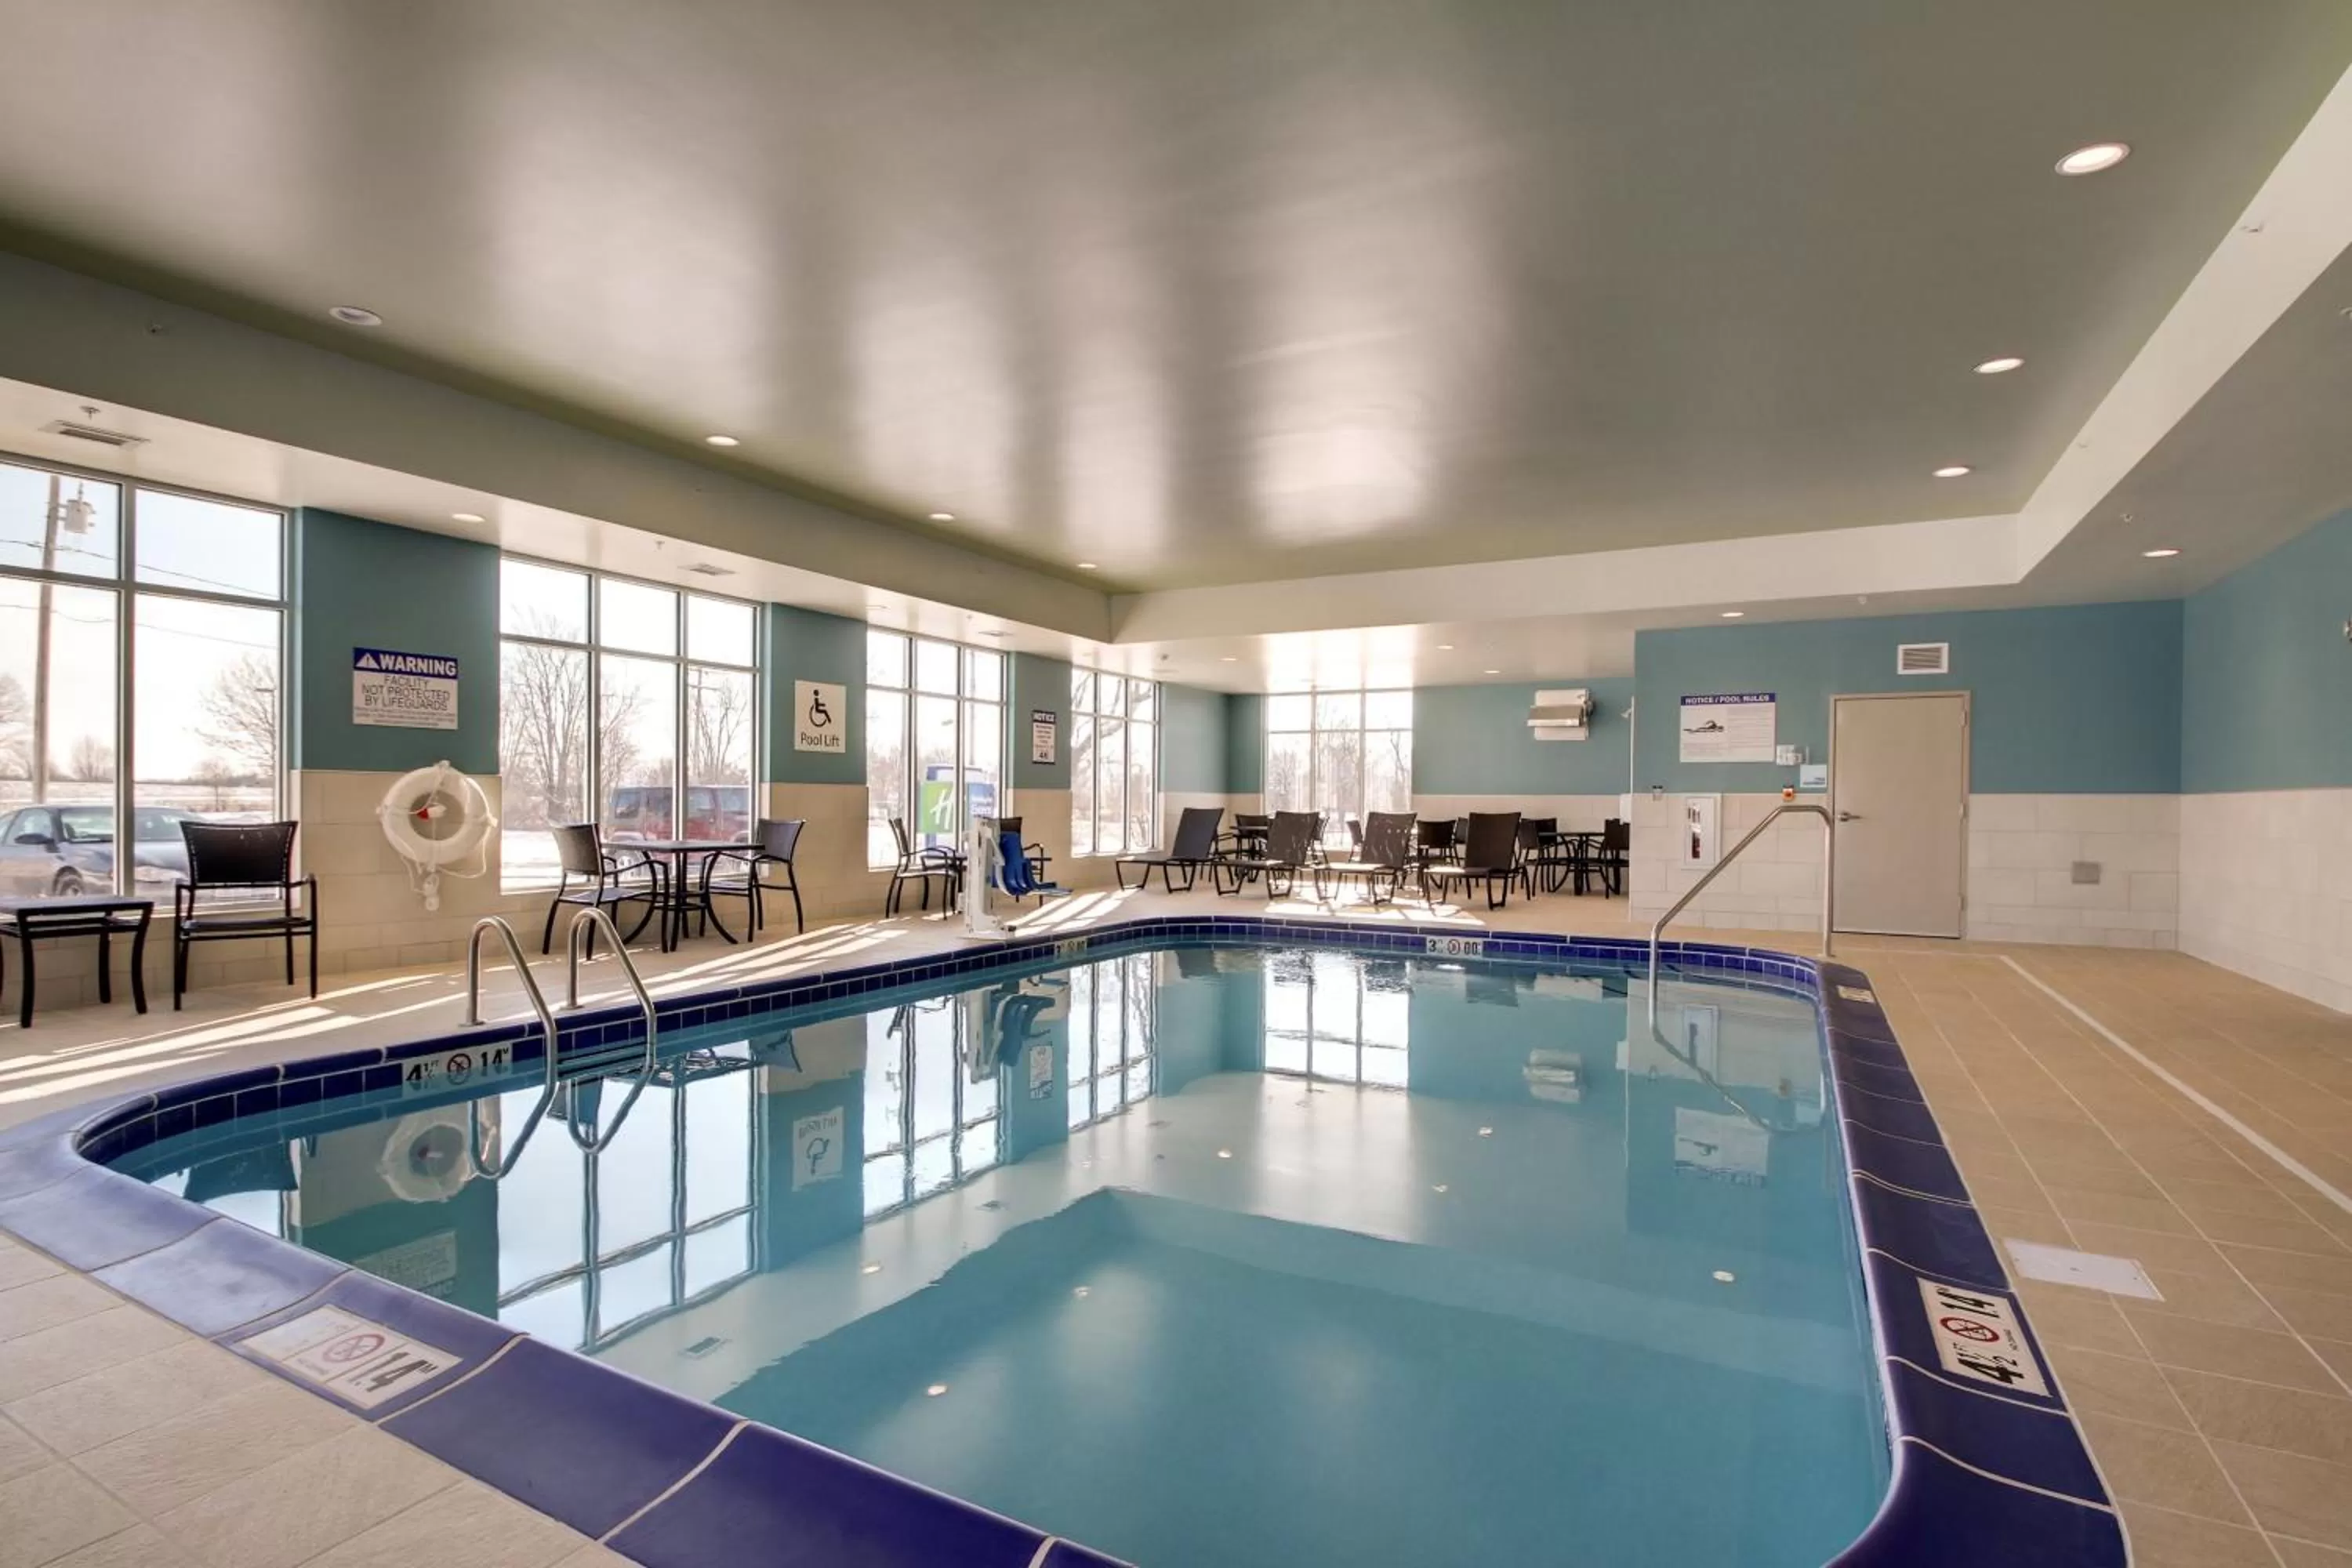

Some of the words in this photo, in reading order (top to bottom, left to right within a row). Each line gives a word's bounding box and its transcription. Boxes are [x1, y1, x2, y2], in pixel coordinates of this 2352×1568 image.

[379, 653, 456, 676] WARNING
[384, 675, 429, 688] FACILITY
[361, 684, 384, 695] NOT
[388, 686, 450, 702] PROTECTED
[365, 695, 378, 706] BY
[382, 697, 448, 710] LIFEGUARDS
[800, 731, 822, 746] Pool
[824, 735, 840, 747] Lift
